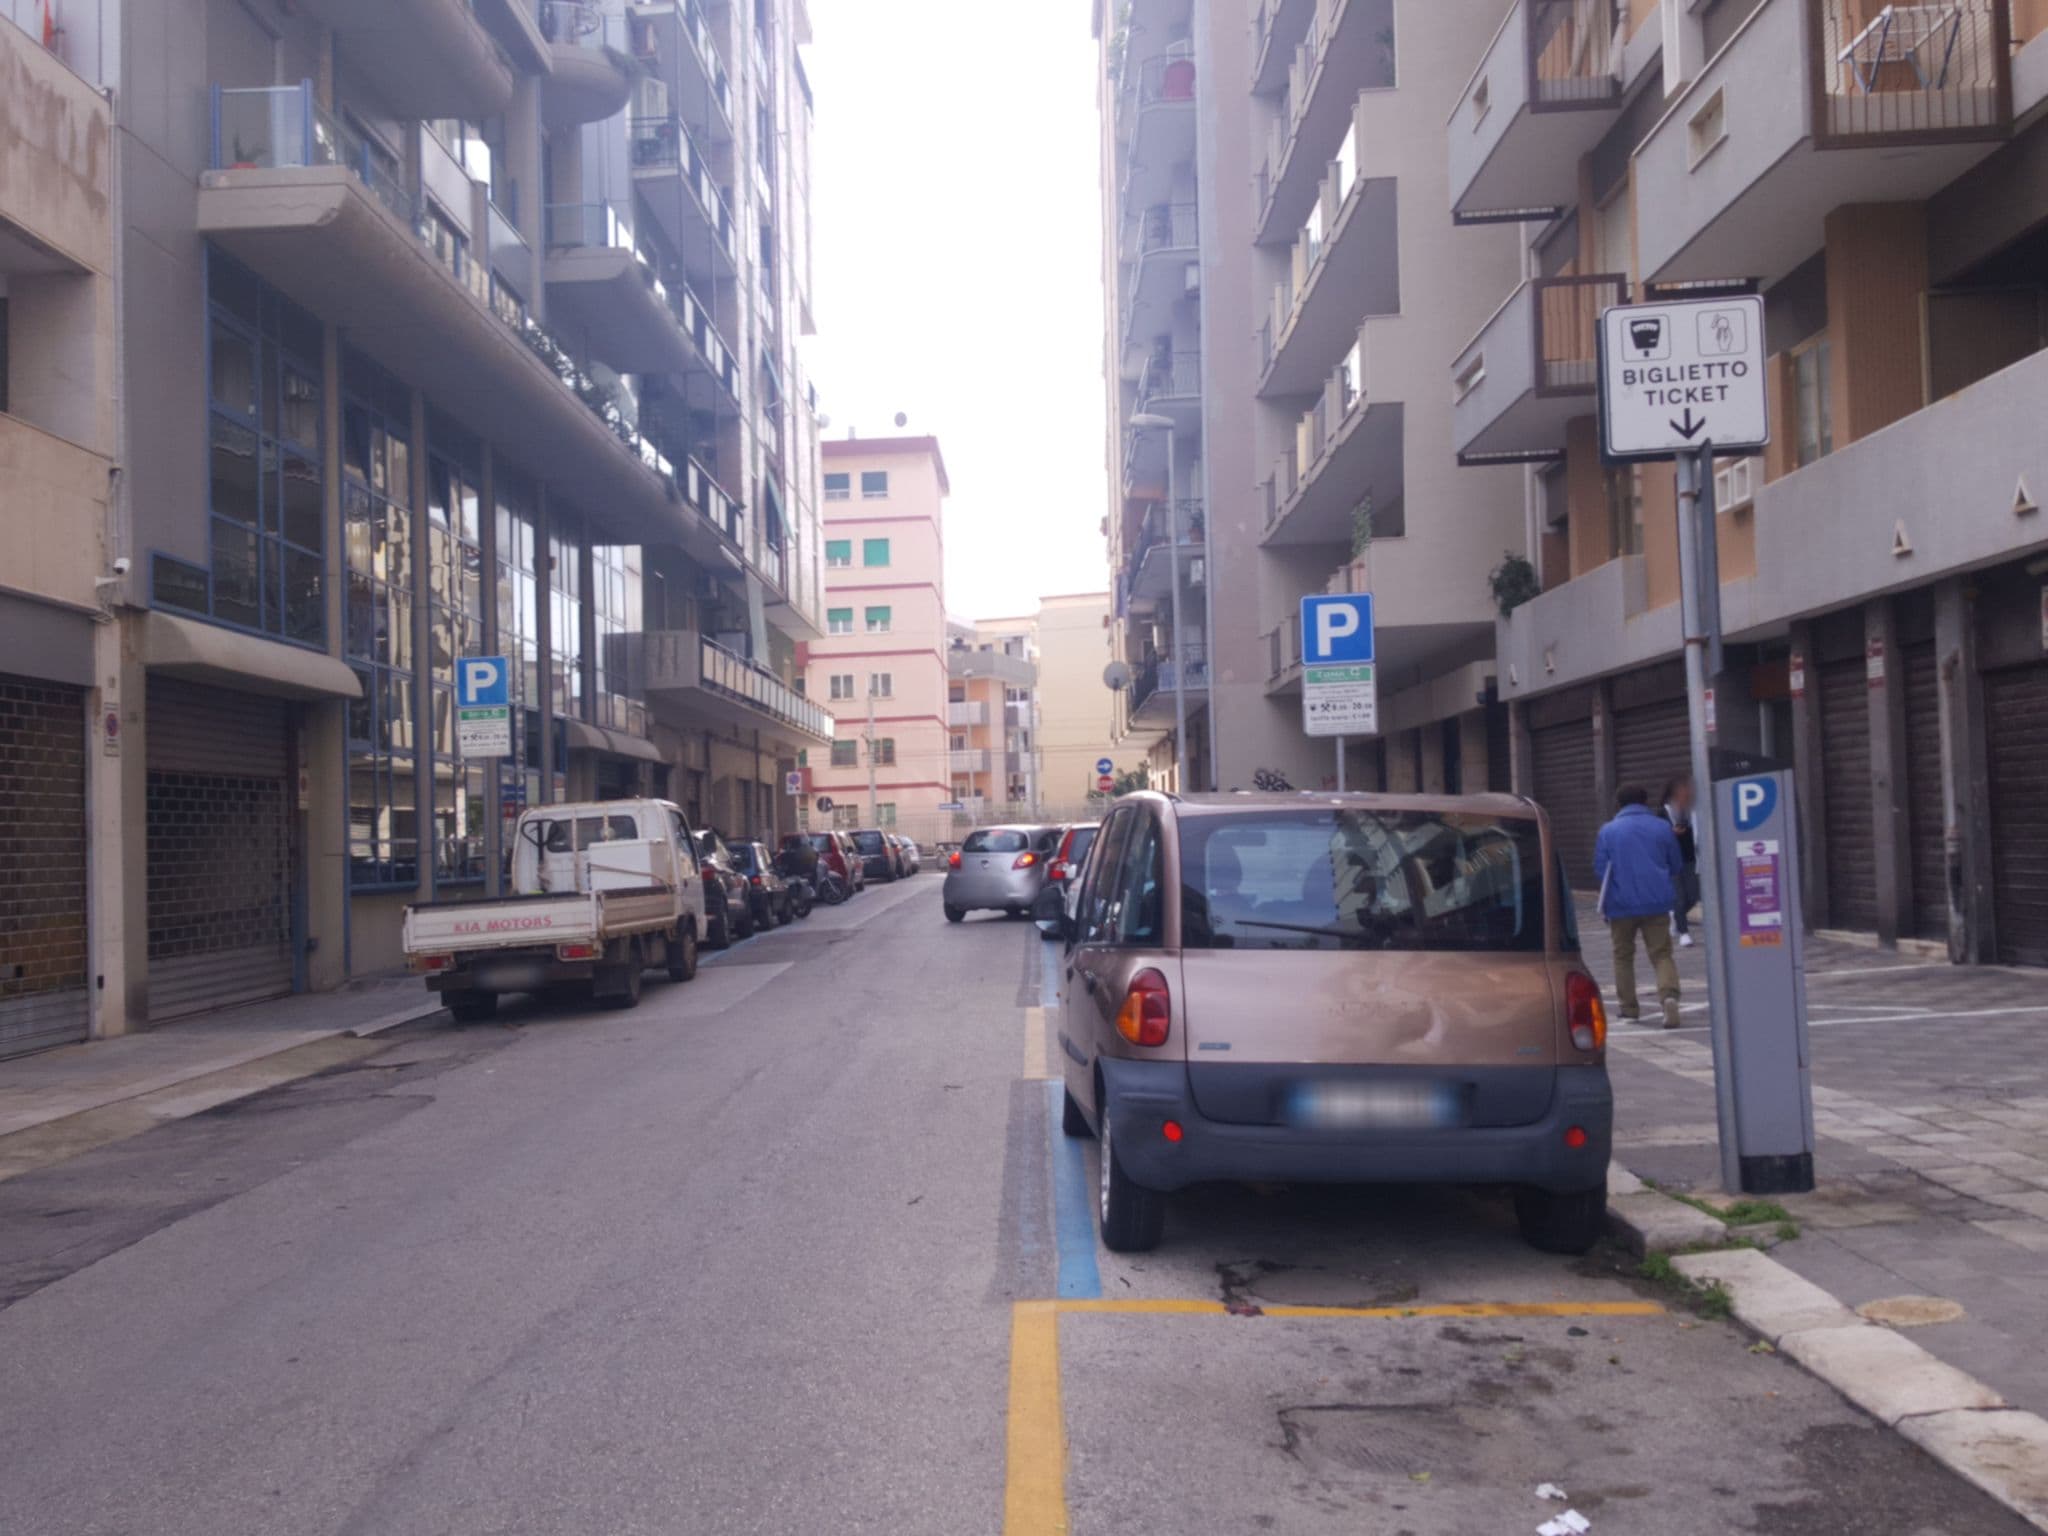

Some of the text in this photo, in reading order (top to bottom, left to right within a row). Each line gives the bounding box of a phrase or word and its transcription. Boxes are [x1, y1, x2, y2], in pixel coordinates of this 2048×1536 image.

[1622, 360, 1748, 386] BIGLIETTO
[1644, 384, 1729, 406] TICKET
[1316, 602, 1359, 656] P
[466, 662, 498, 702] P
[1738, 783, 1765, 821] P
[453, 916, 553, 933] KIA MOTORS
